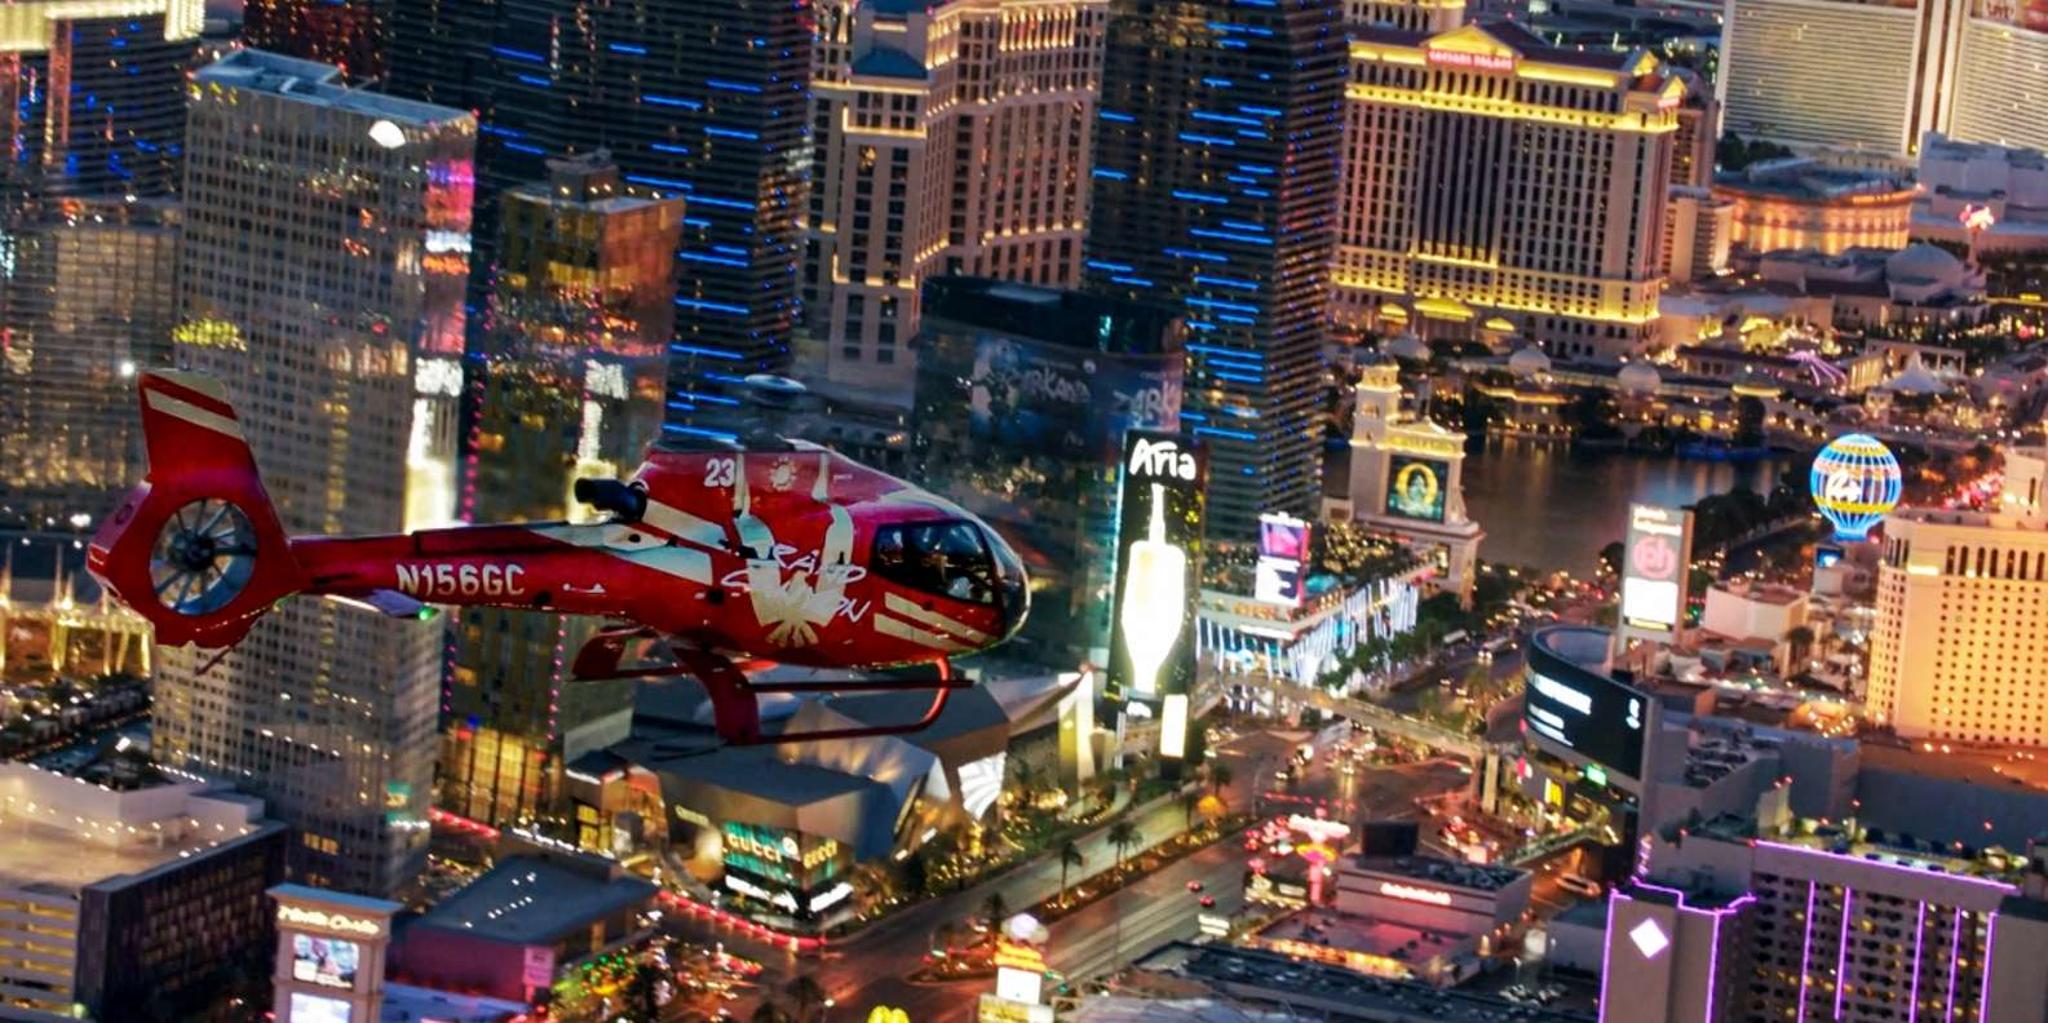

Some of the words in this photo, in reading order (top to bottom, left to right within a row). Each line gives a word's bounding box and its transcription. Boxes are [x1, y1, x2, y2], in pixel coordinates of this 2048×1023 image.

[704, 458, 735, 488] 23
[396, 563, 525, 596] N156GC
[727, 832, 782, 863] GUCCI
